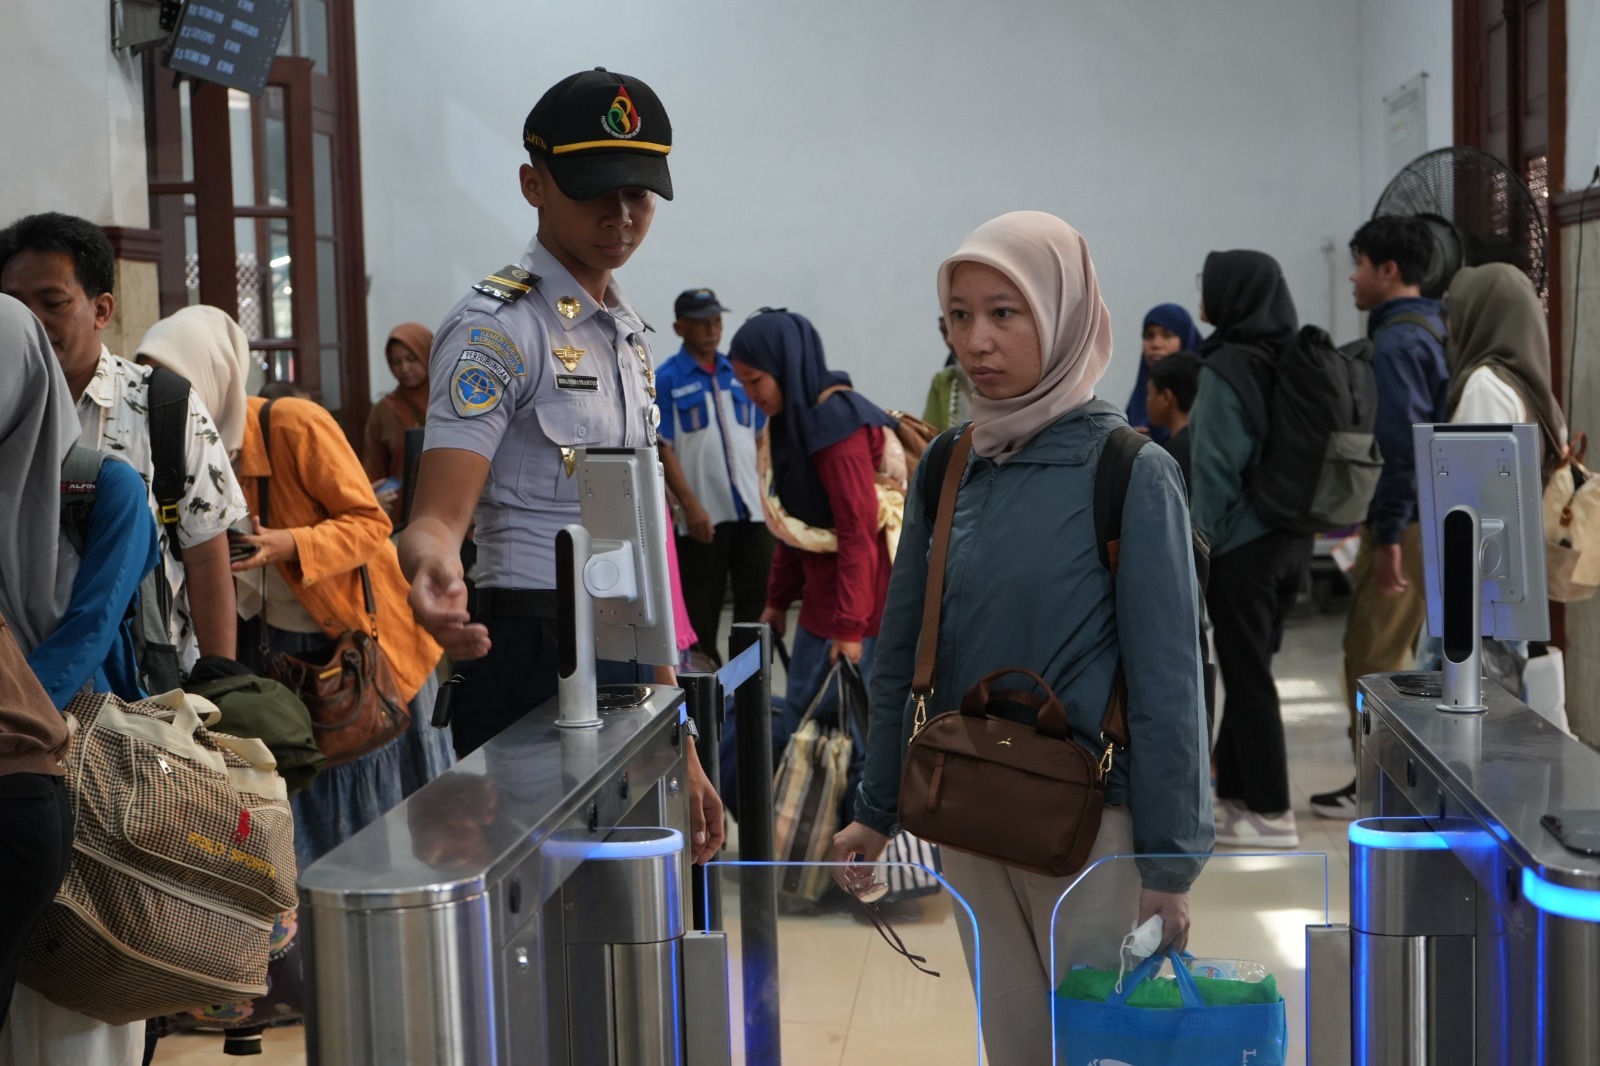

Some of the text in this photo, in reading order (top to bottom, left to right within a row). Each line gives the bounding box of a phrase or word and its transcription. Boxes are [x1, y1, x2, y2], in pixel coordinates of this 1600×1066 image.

[465, 351, 509, 381] PERHUBUNGAN
[474, 335, 519, 373] PERHUBUNGAN
[480, 330, 521, 366] KEMENTERIAN
[188, 832, 276, 879] POLO SPORTS
